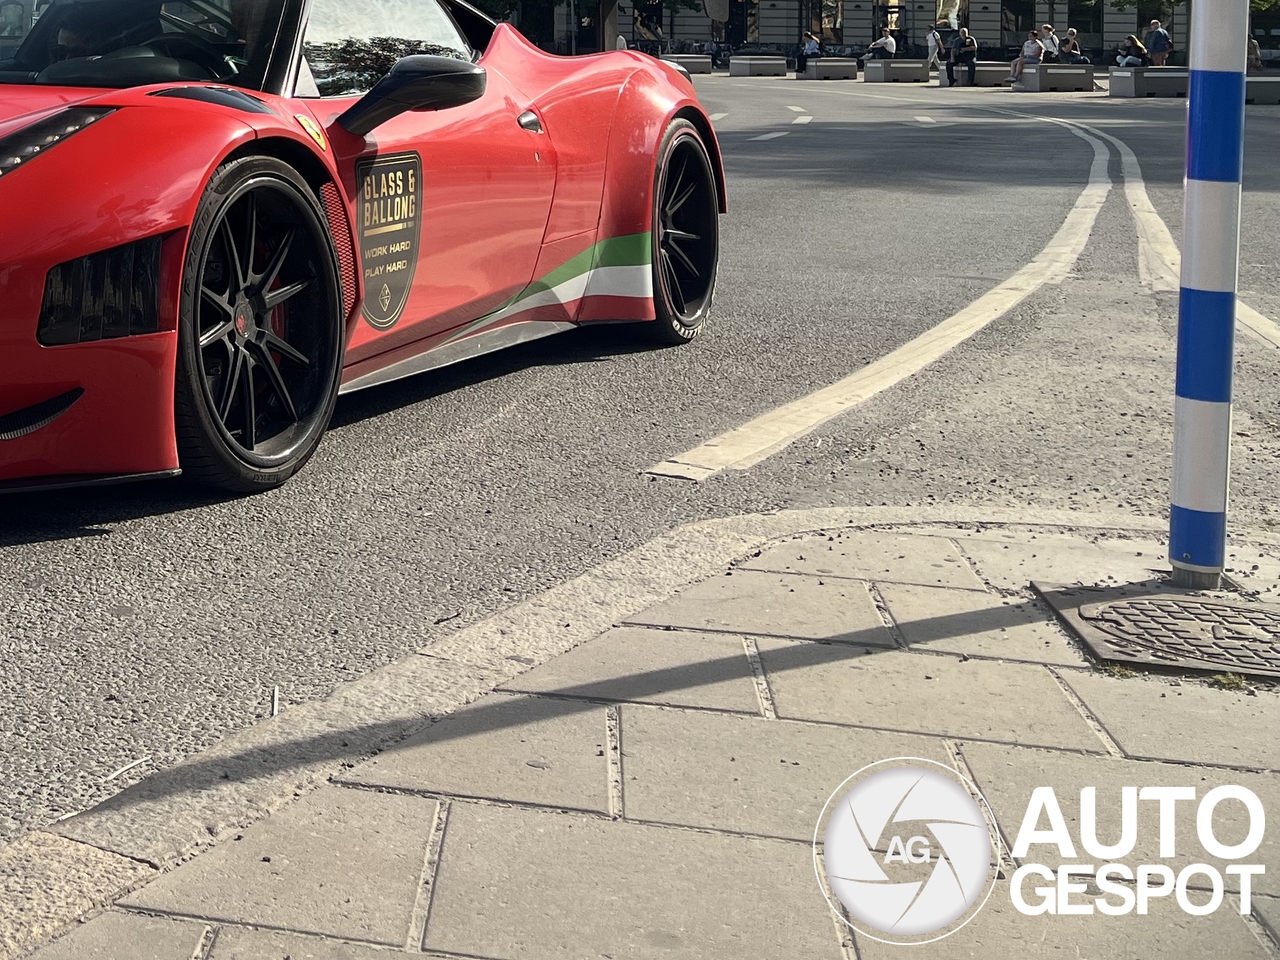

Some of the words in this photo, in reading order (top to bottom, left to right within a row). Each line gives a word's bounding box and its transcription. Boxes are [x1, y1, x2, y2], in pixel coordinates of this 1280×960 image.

[364, 171, 403, 200] GLASS
[408, 169, 416, 192] &
[364, 194, 416, 227] BALLONG
[364, 245, 388, 260] WORK
[389, 240, 411, 254] HARD
[364, 265, 385, 279] PLAY
[386, 259, 408, 273] HARD
